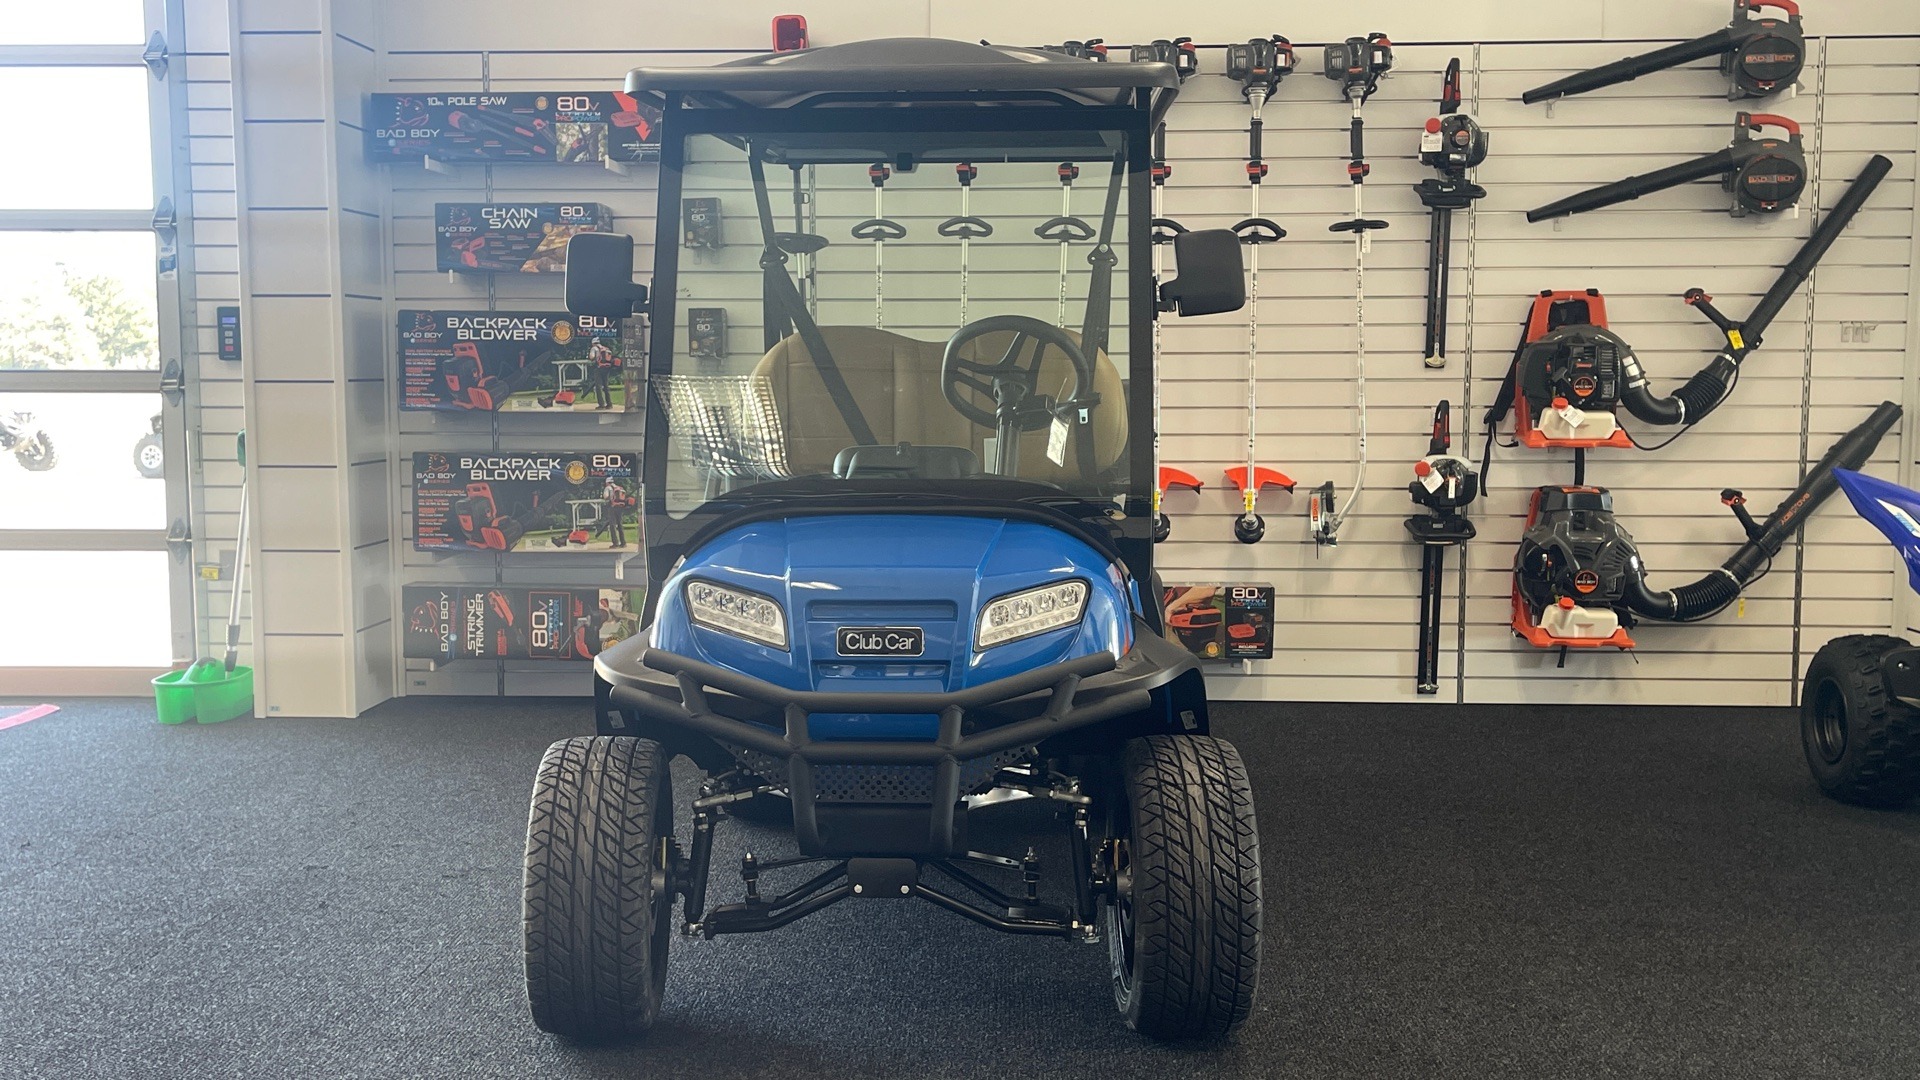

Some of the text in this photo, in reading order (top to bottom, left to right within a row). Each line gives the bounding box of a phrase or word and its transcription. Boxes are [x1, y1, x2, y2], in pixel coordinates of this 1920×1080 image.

[448, 97, 476, 106] POLE
[480, 97, 507, 106] SAW
[376, 129, 406, 138] BAD
[411, 129, 440, 138] BOY
[481, 207, 538, 219] CHAIN
[489, 218, 531, 229] SAW
[447, 317, 547, 329] BACKPACK
[457, 329, 537, 340] BLOWER
[461, 457, 561, 469] BACKPACK
[470, 470, 551, 481] BLOWER
[440, 591, 449, 652] BAD BOY
[467, 599, 476, 650] STRING
[475, 593, 484, 656] TRIMMER
[845, 633, 915, 650] Club Car
